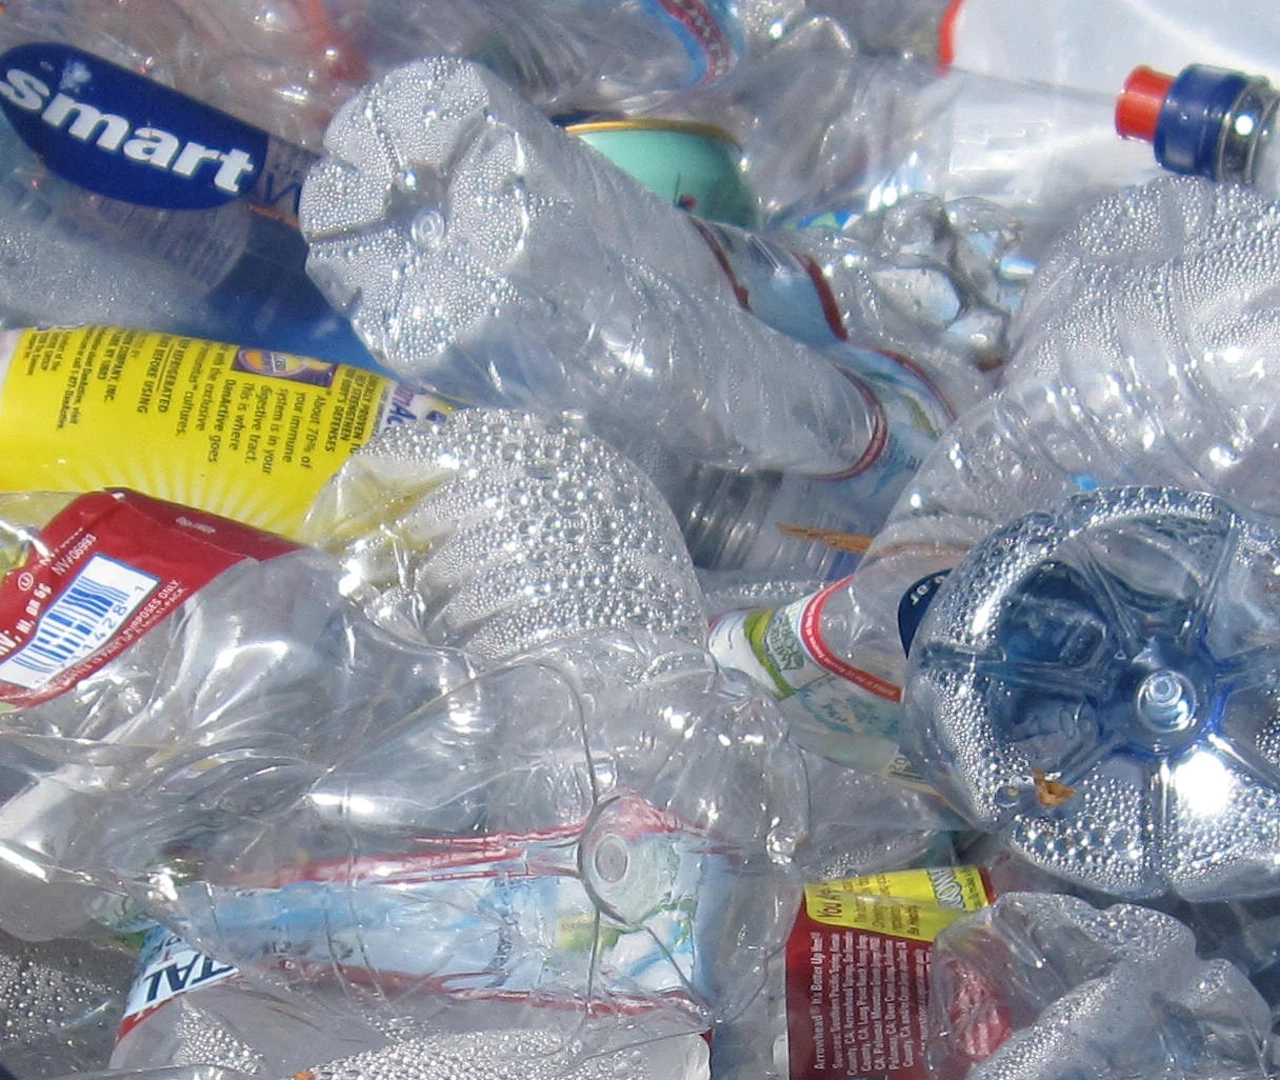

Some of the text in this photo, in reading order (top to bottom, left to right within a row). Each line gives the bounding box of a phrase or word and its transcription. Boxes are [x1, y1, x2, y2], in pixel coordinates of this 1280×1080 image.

[135, 379, 153, 414] USING
[156, 347, 184, 414] REFRIGERATED
[173, 389, 194, 438] cultures.
[194, 382, 217, 432] exclusive
[262, 387, 289, 474] system your
[208, 435, 221, 464] goes
[229, 419, 246, 452] where
[282, 416, 300, 463] immune
[810, 952, 825, 964] Up
[811, 1014, 825, 1069] Arrowhead
